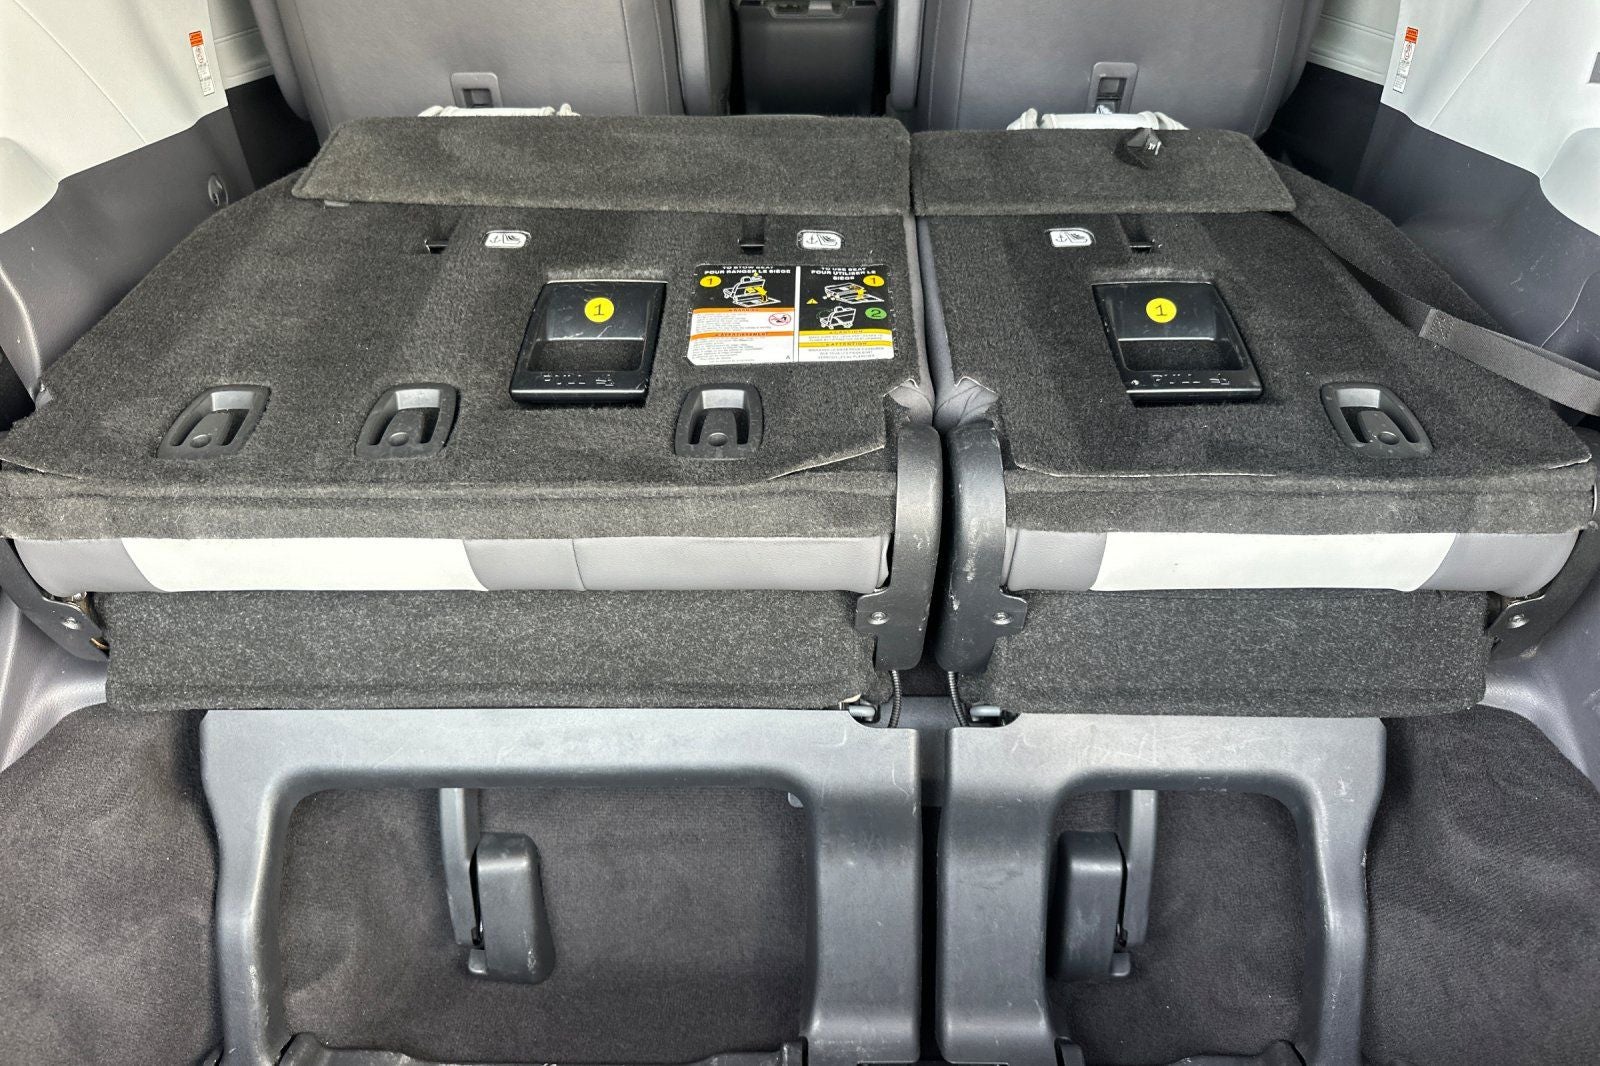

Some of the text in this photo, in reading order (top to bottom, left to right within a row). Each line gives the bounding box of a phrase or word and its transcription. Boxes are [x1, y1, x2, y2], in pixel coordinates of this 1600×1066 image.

[593, 303, 605, 316] 1
[870, 309, 881, 317] 2
[1155, 304, 1167, 316] 1
